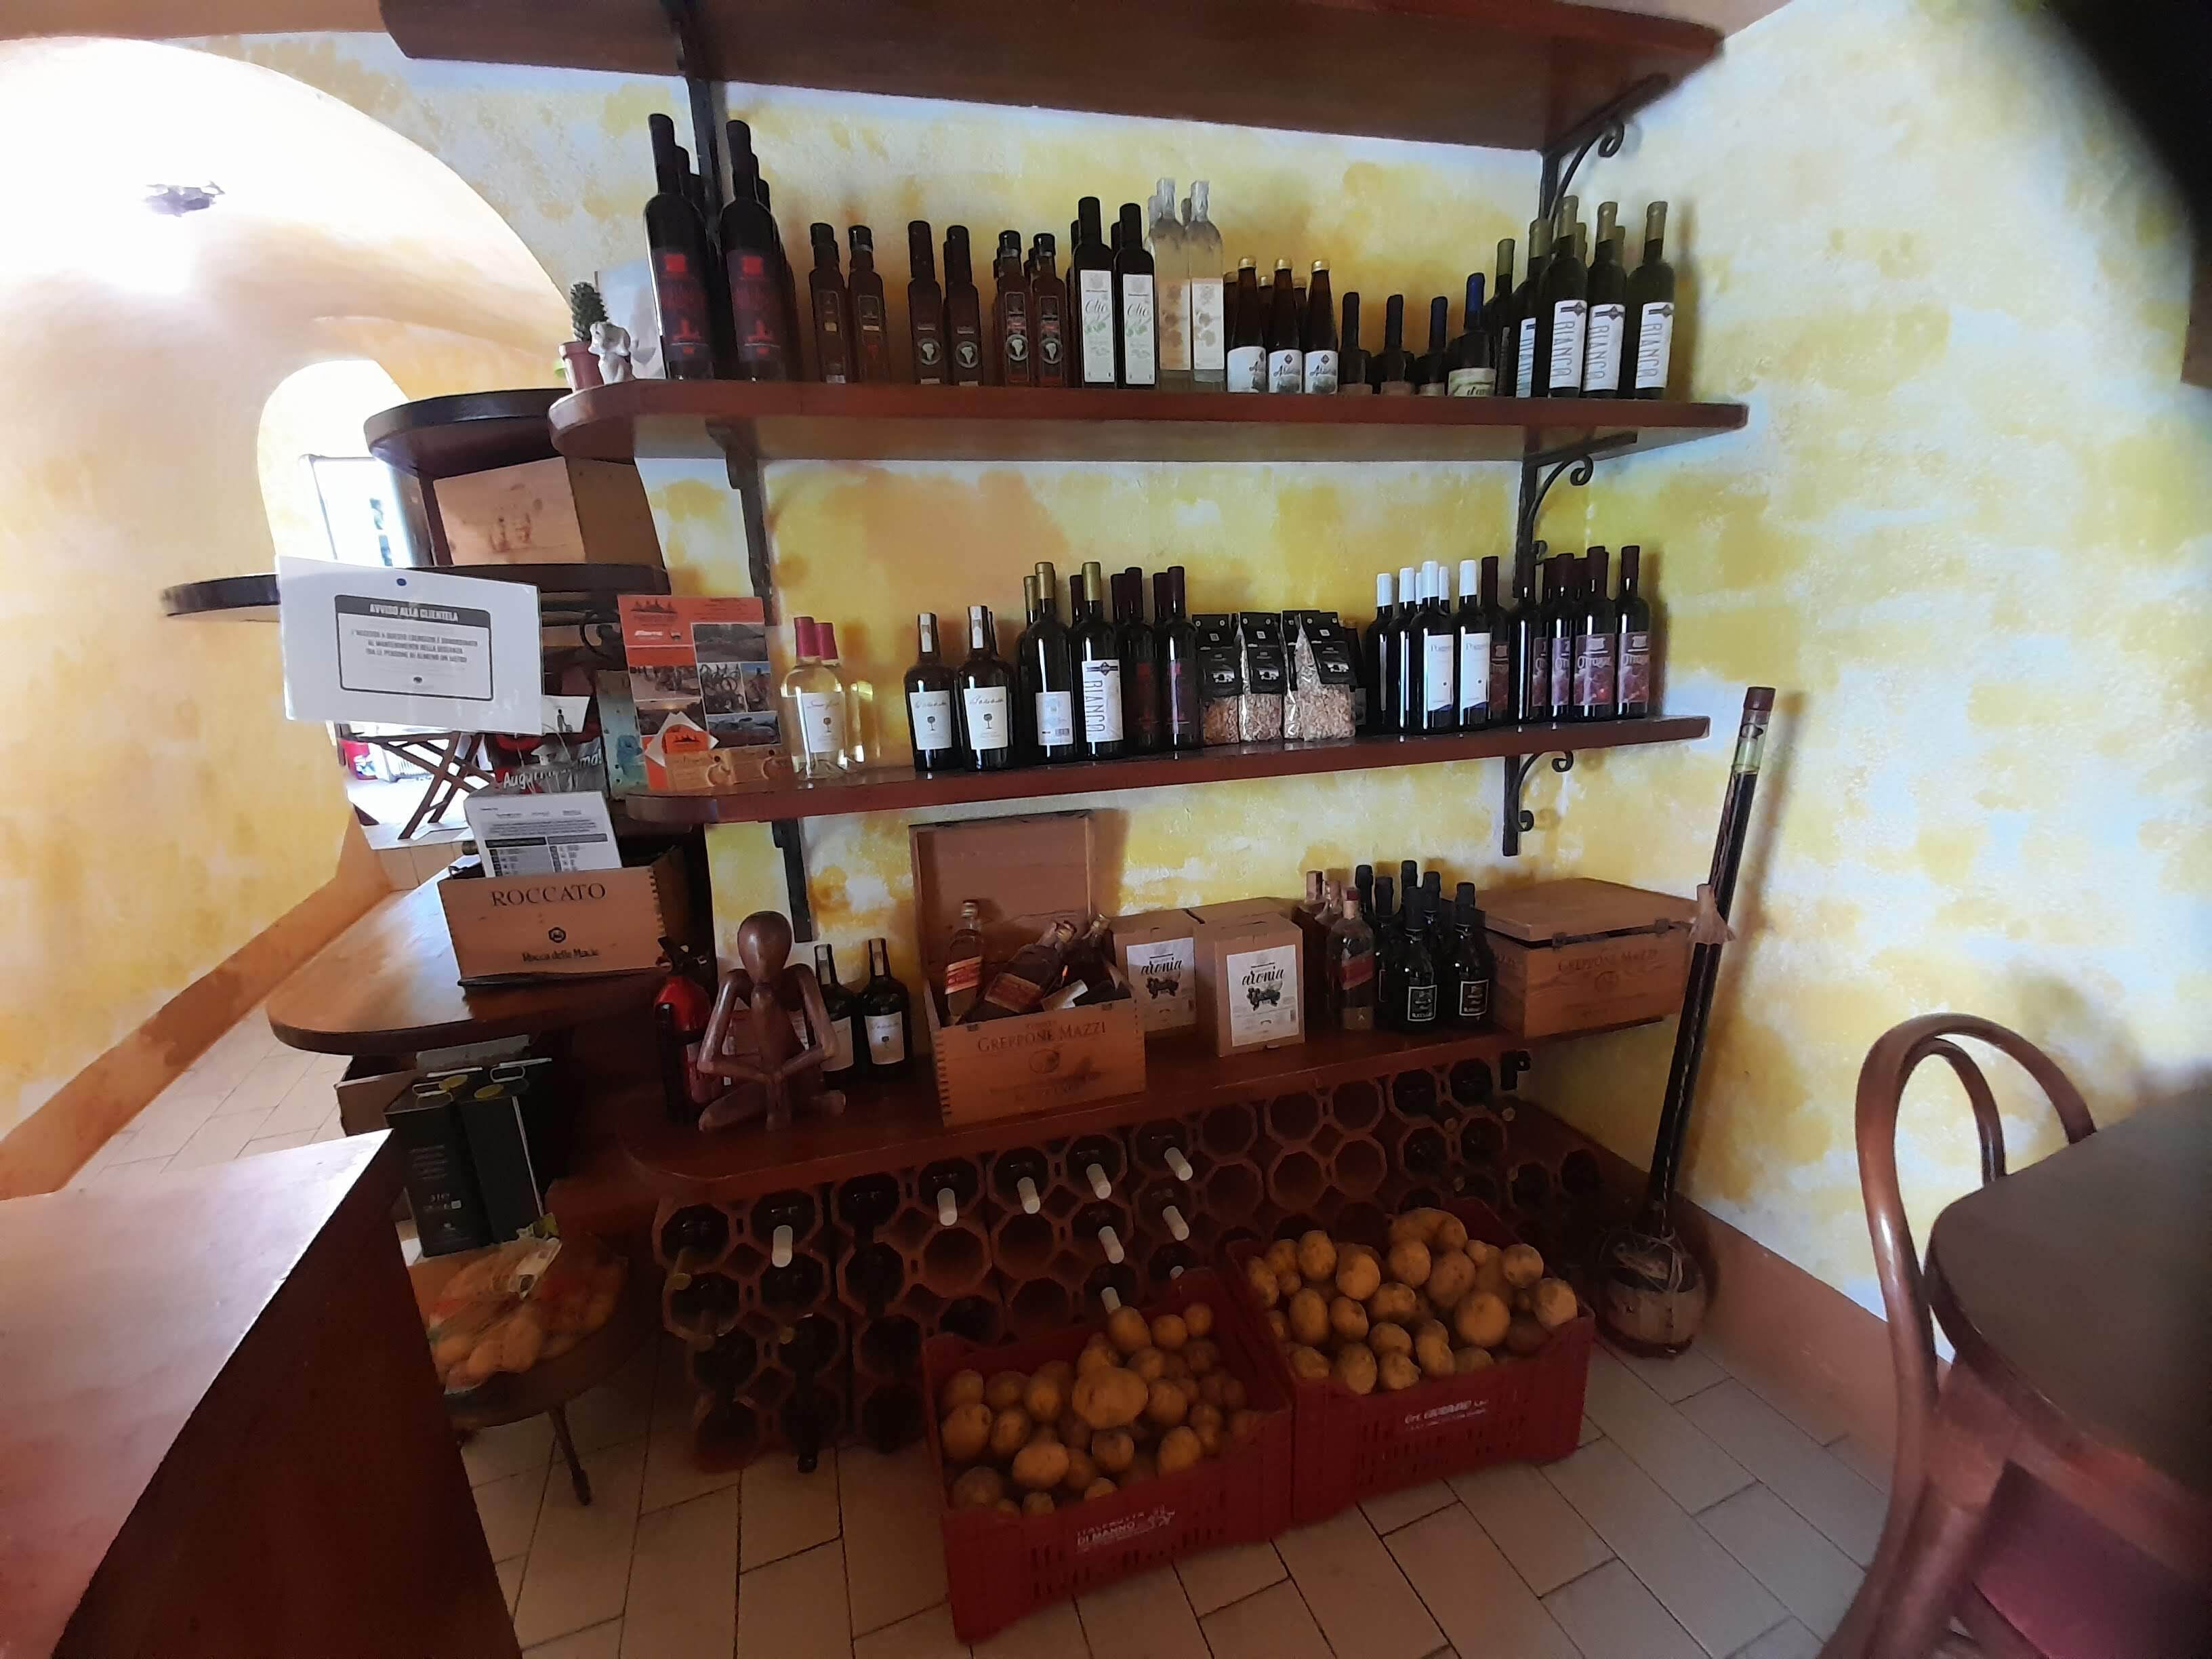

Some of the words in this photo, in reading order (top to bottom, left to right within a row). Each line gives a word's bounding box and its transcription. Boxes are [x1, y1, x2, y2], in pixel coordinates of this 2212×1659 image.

[491, 883, 606, 907] ROCCATO
[1141, 957, 1183, 976] aronia
[1242, 966, 1284, 986] aronia
[978, 1030, 1053, 1052] GREPPONE
[1060, 1021, 1106, 1039] MAZZI
